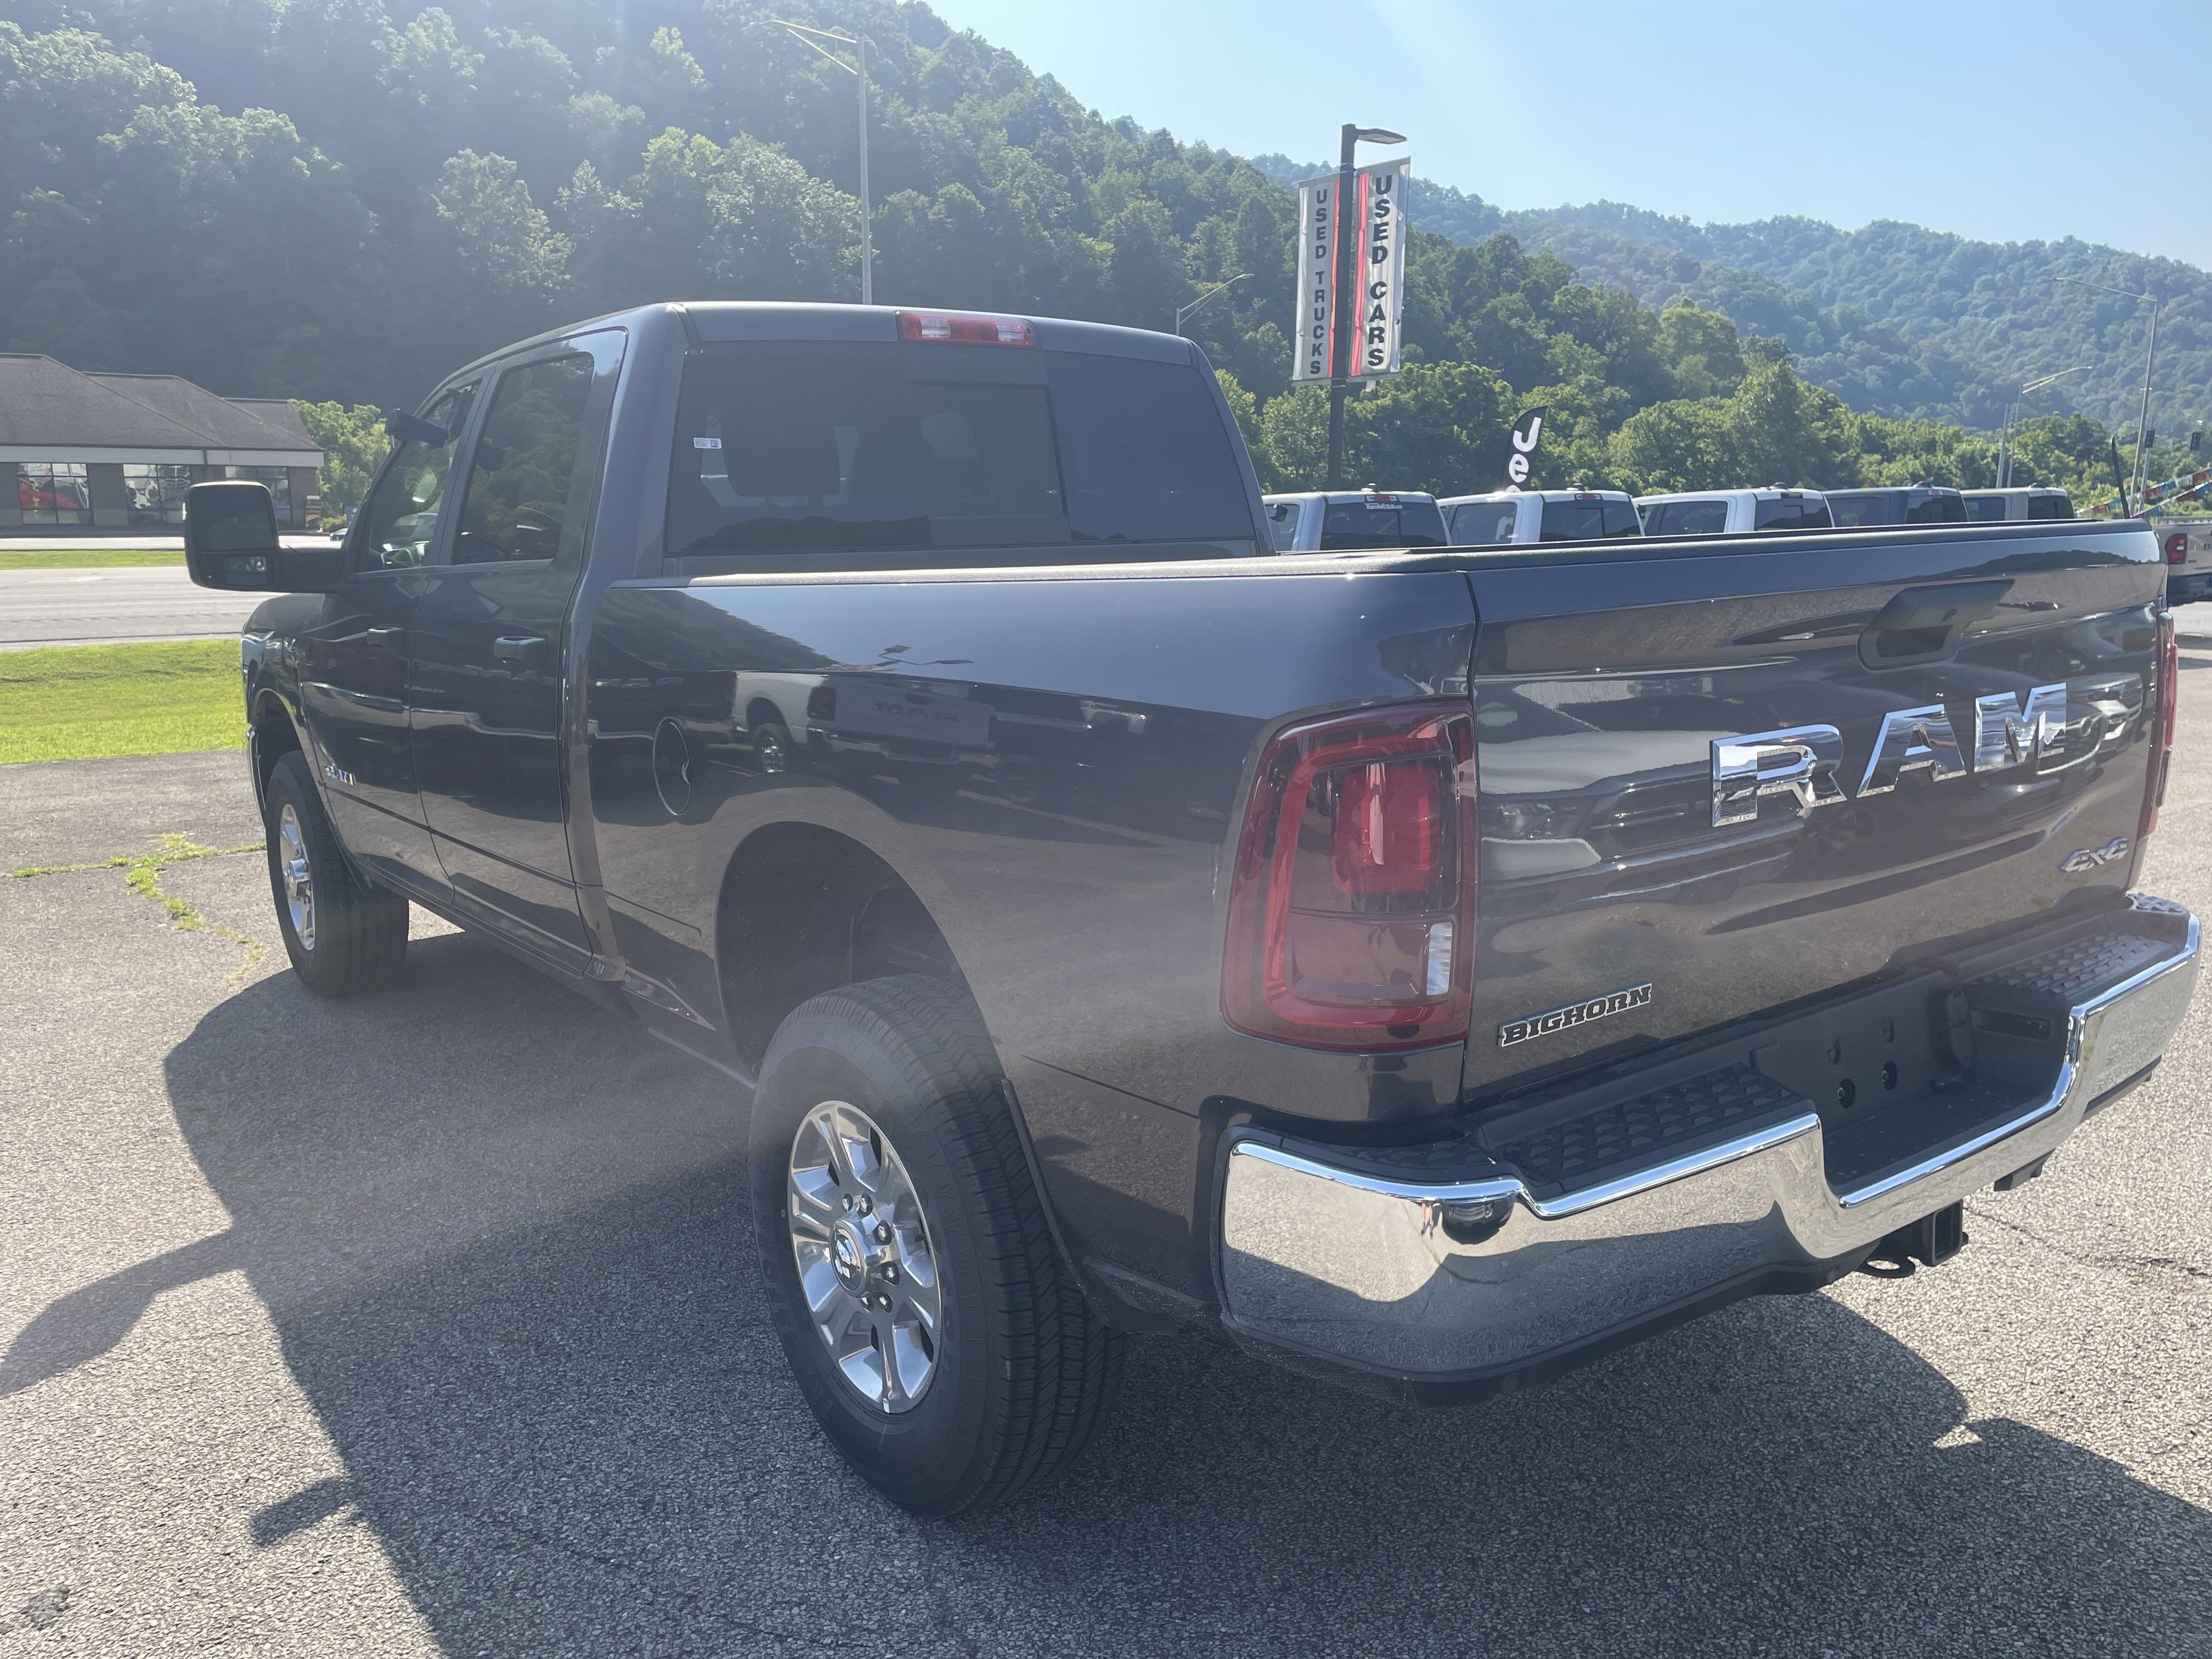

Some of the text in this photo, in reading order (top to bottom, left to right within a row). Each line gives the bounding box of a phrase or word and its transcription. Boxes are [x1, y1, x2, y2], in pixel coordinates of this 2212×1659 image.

[1310, 189, 1328, 375] USED TRUCKS
[1368, 174, 1392, 366] USED CARS
[1505, 416, 1542, 492] Je
[1709, 681, 2067, 827] RAM
[1501, 983, 1652, 1047] BIGHORN
